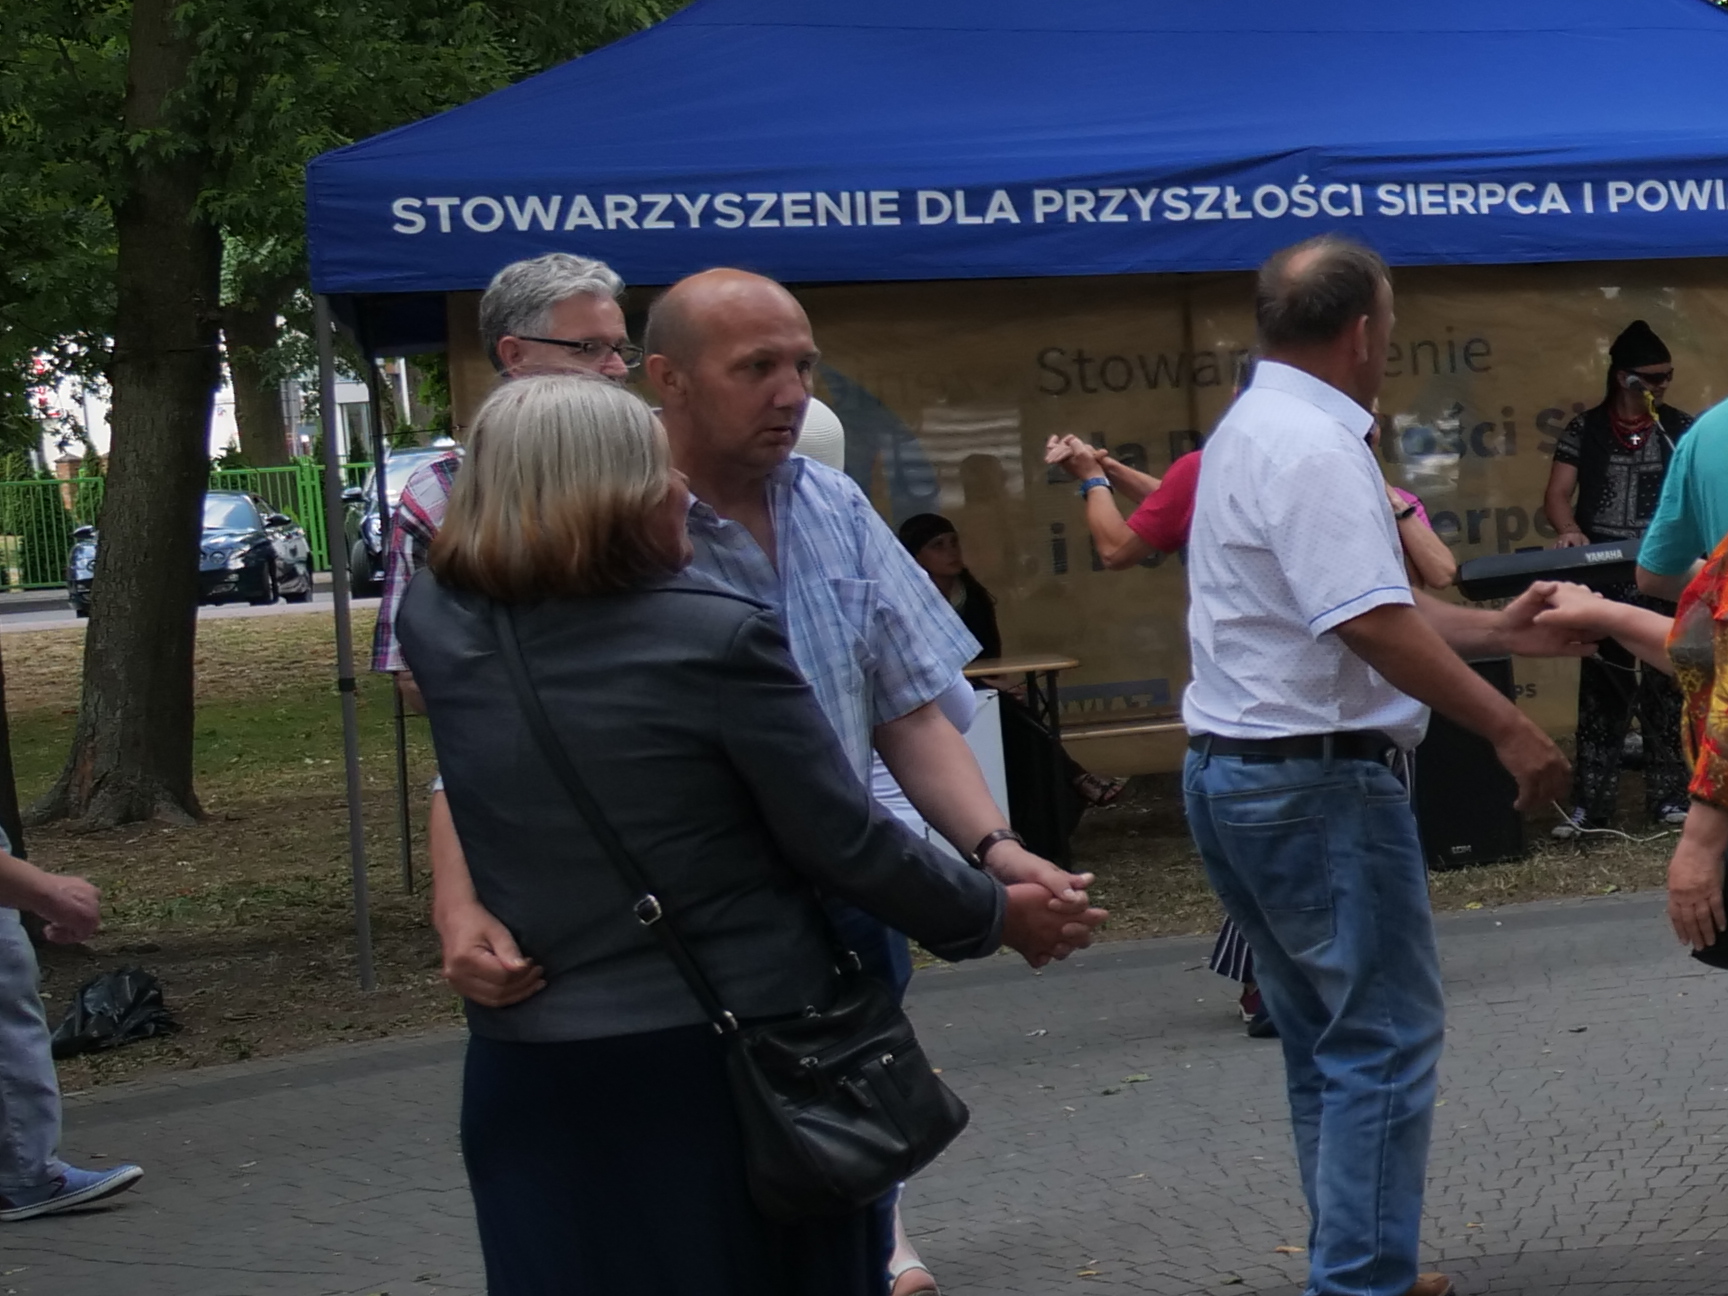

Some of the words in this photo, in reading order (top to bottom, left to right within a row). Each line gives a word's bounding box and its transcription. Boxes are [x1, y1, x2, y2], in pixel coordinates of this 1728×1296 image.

[391, 189, 900, 235] STOWARZYSZENIE
[916, 188, 1018, 226] DLA
[1033, 174, 1362, 225] PRZYSZŁOŚCI
[1378, 181, 1571, 218] SIERPCA
[1583, 182, 1593, 213] I
[1585, 549, 1624, 563] YAMAHA
